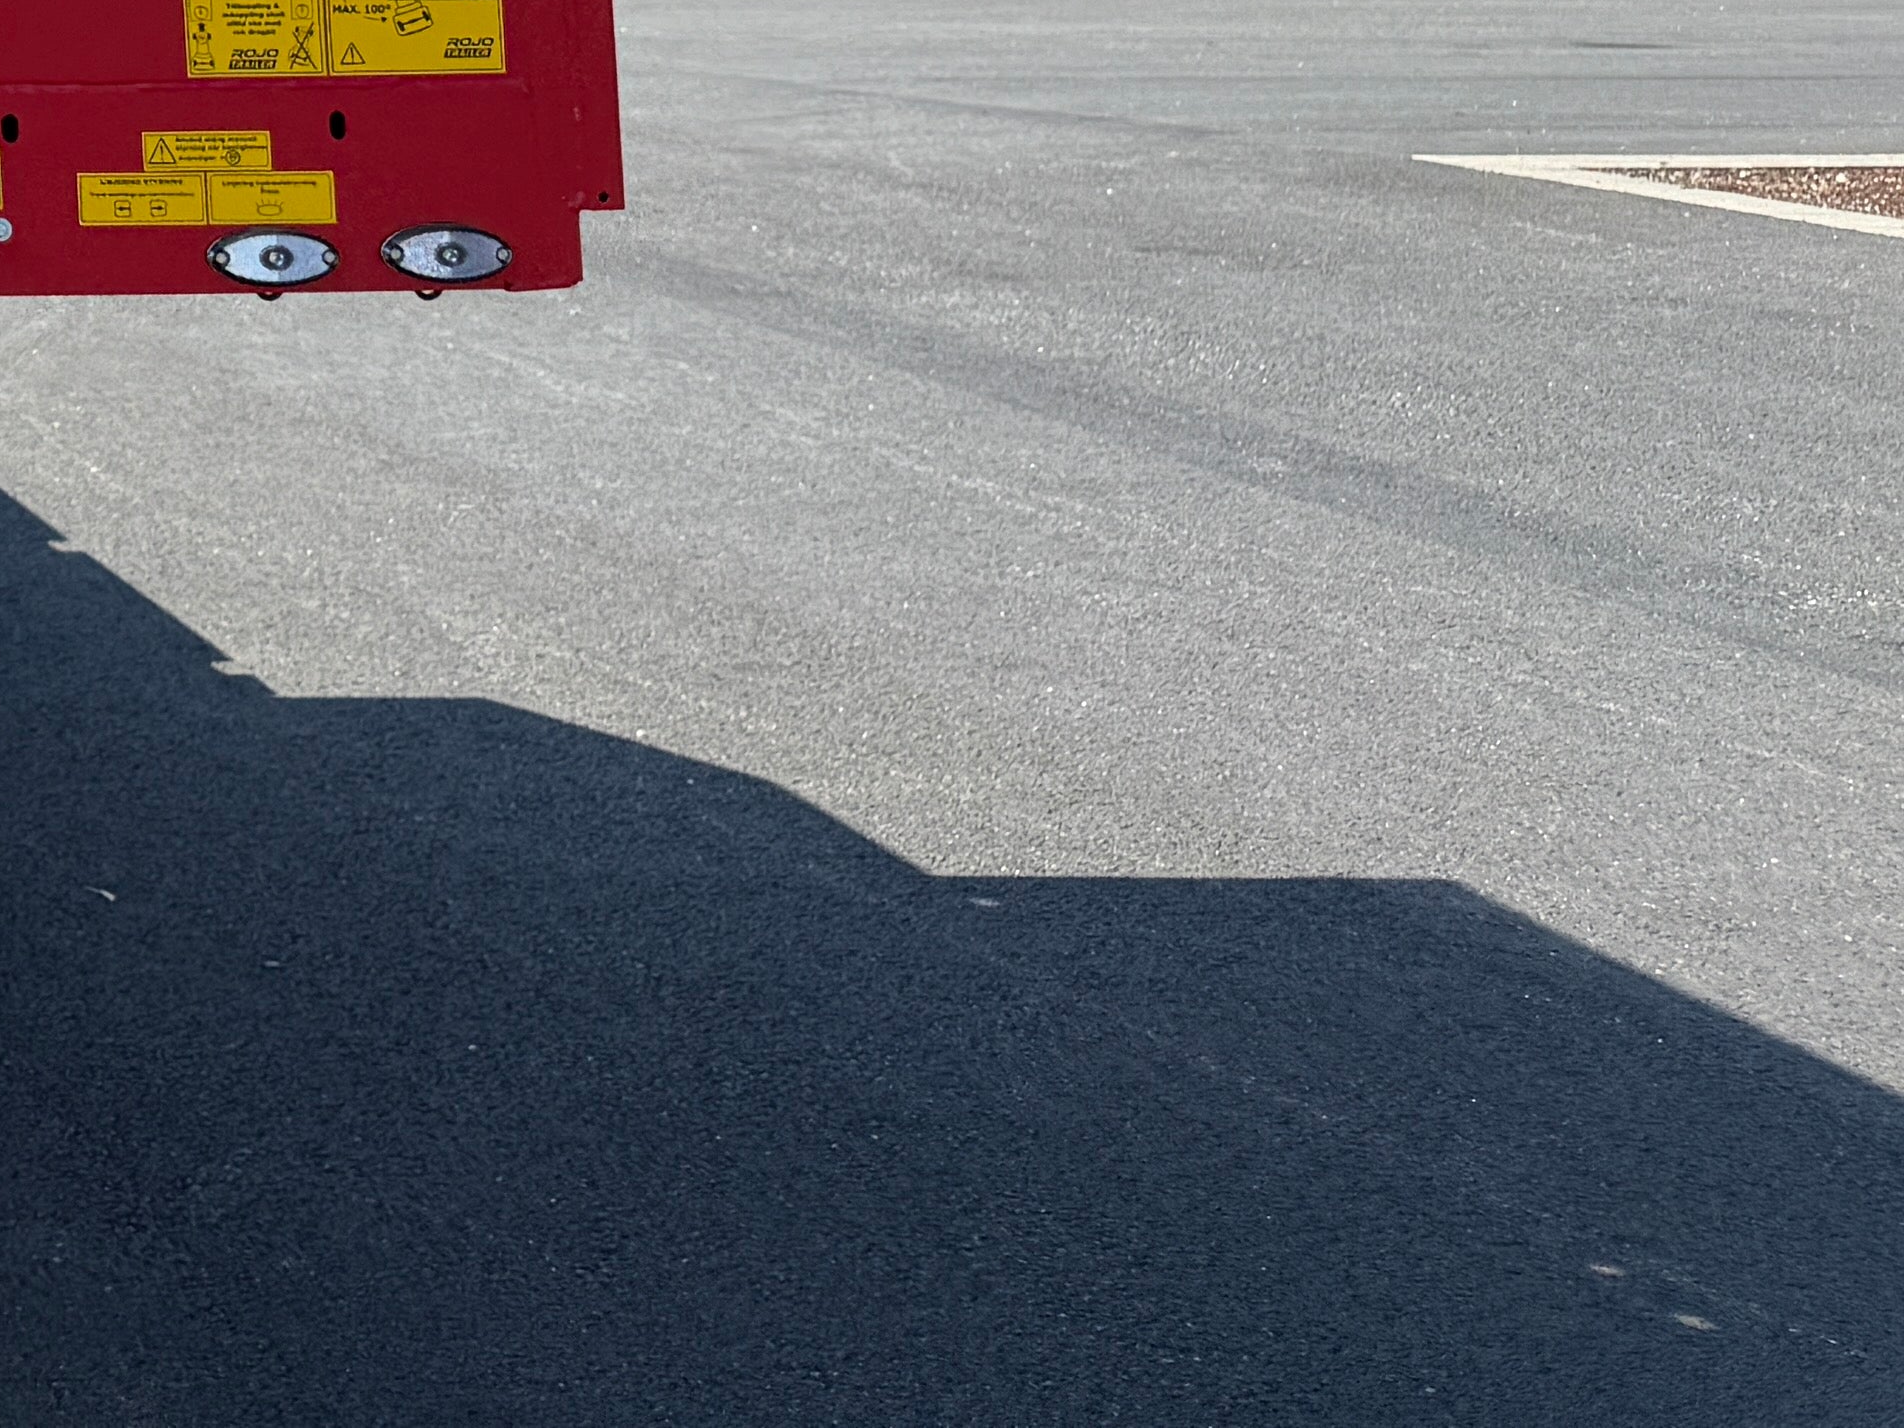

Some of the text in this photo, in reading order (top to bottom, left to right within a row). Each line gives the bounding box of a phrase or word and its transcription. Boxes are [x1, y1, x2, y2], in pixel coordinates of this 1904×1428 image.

[332, 4, 360, 14] MAX.
[446, 37, 494, 47] ROJO
[231, 48, 279, 58] ROJO
